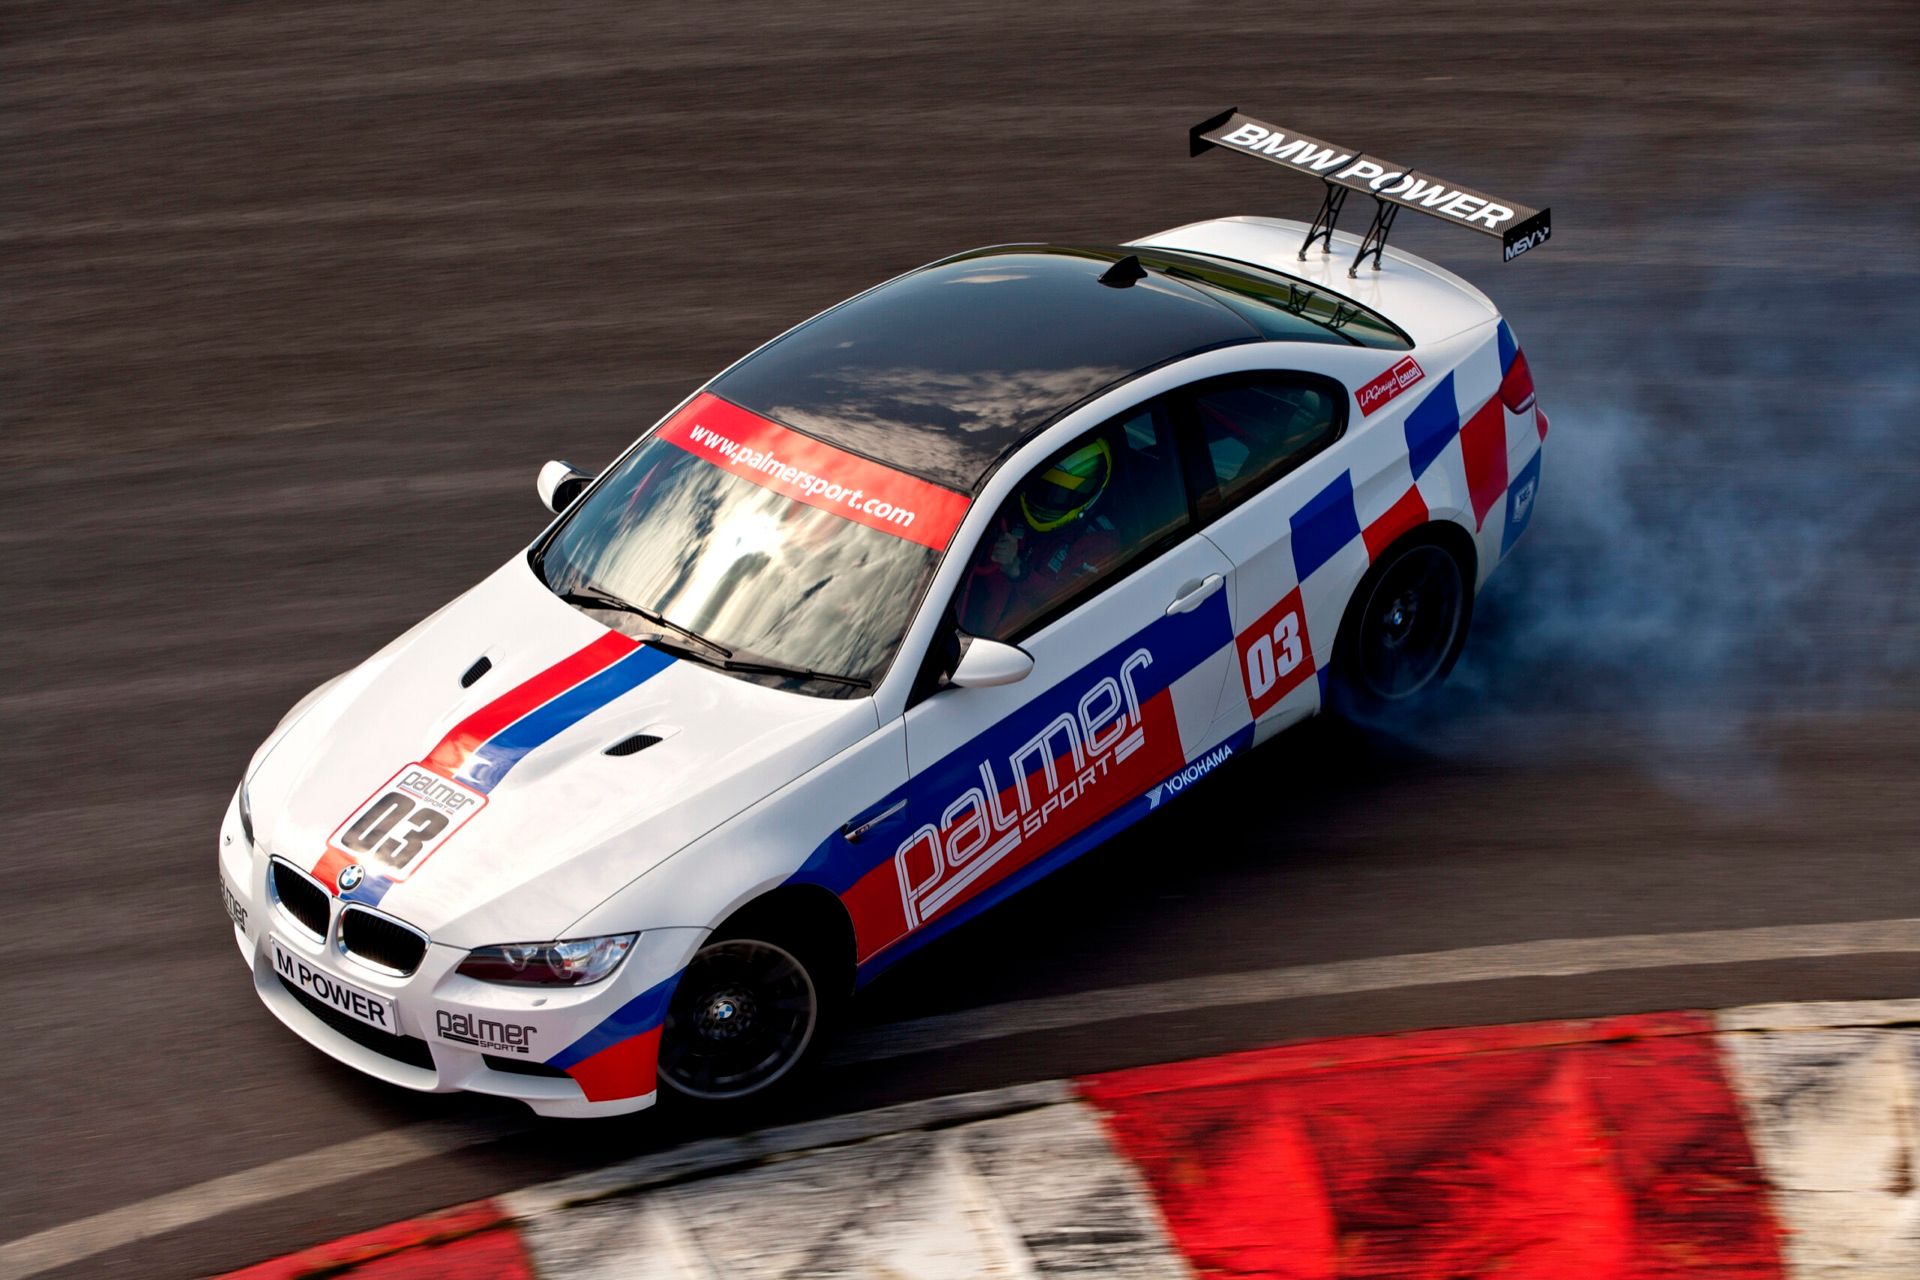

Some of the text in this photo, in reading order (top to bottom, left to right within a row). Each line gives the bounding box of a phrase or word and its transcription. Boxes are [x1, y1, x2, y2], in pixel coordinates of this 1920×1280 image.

[1221, 122, 1515, 229] BMW POWER
[1505, 231, 1536, 261] MSV
[688, 423, 916, 528] www.palmersport.com
[1245, 611, 1303, 701] 03
[396, 771, 476, 811] palmer
[894, 647, 1154, 931] palmer
[1024, 754, 1113, 839] SPORT
[1164, 744, 1233, 795] YOKOHAMA
[340, 791, 450, 870] 03
[276, 946, 388, 1027] M POWER
[436, 1009, 538, 1046] palmer
[480, 1040, 516, 1053] SPORT
